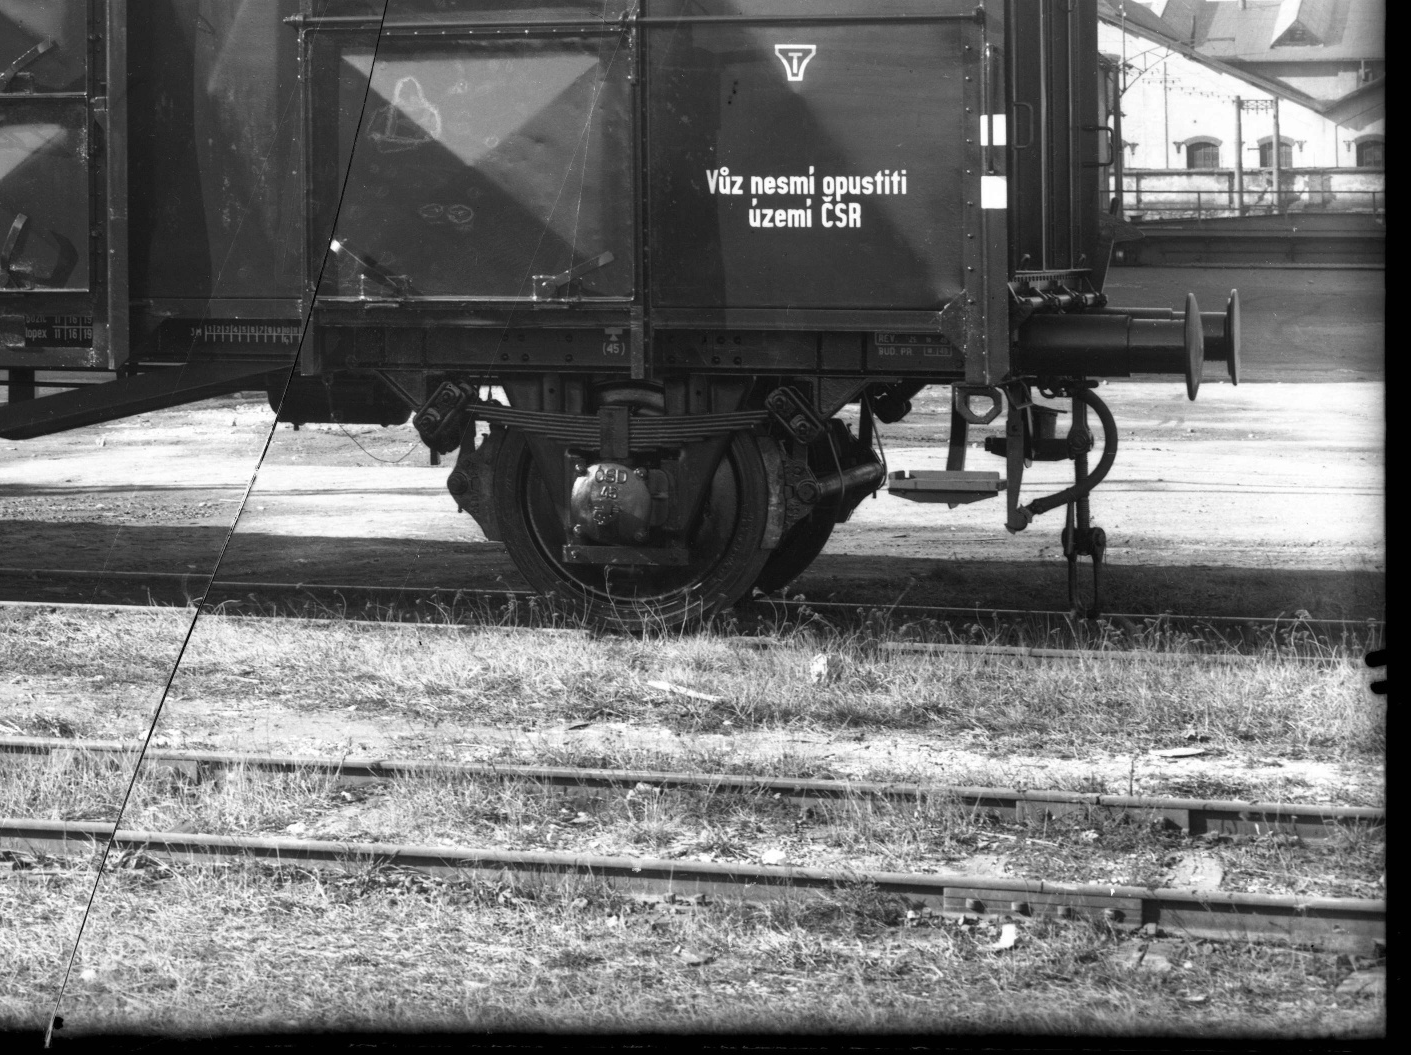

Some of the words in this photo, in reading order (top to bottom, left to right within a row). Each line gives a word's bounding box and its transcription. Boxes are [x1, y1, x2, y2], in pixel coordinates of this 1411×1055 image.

[706, 166, 744, 195] Vůz
[750, 165, 815, 195] nesmí
[822, 169, 907, 202] opustiti
[748, 197, 813, 228] území
[821, 195, 862, 228] ČSR
[602, 342, 626, 356] (45)
